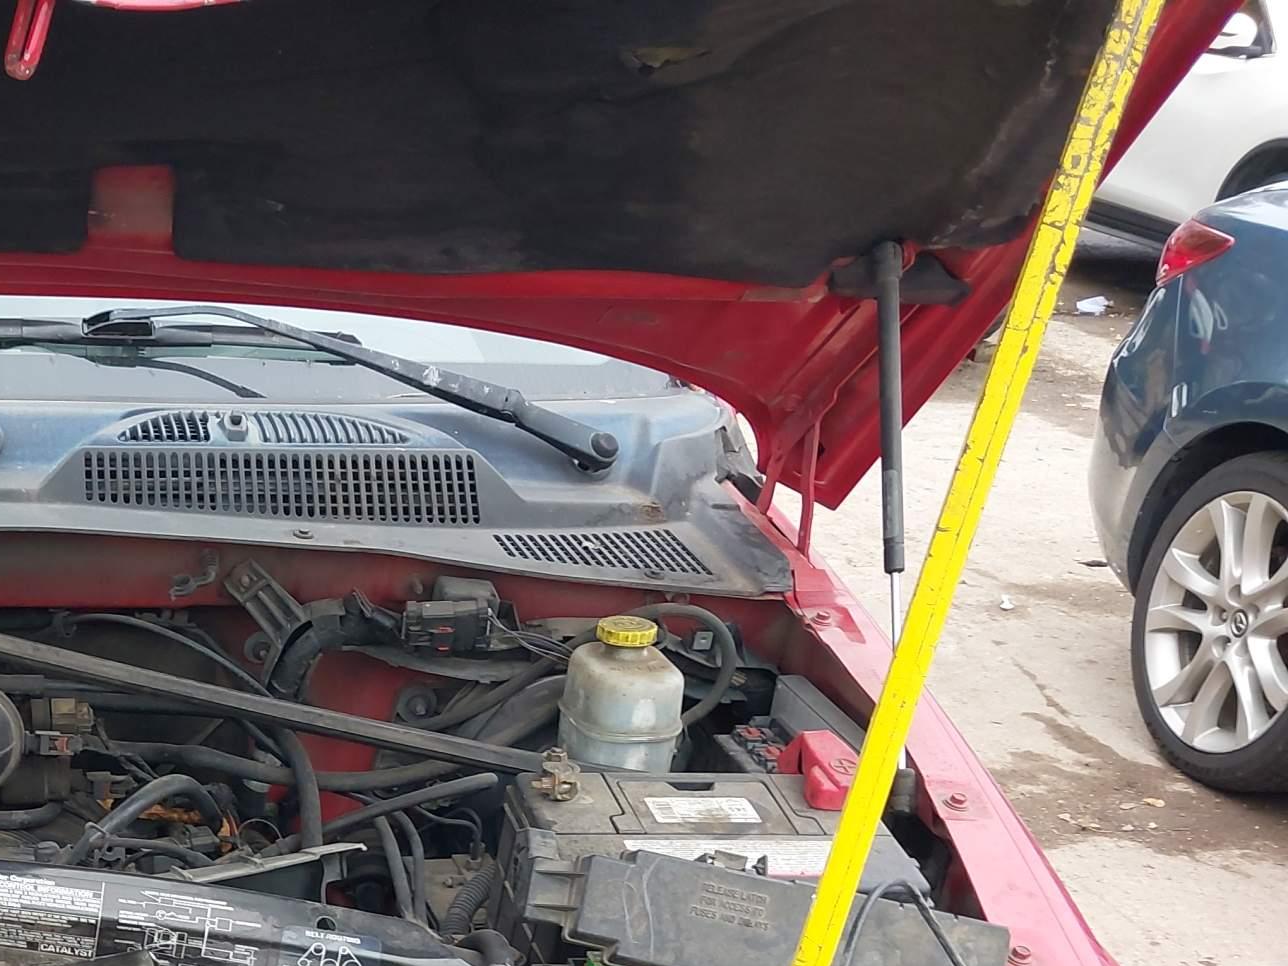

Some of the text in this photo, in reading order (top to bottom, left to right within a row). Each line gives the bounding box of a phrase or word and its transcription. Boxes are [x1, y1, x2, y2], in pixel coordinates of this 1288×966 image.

[36, 884, 94, 898] INFORMATION
[703, 881, 769, 905] RELEASE LATCH
[689, 904, 718, 920] FUSES
[699, 895, 717, 907] FOR
[719, 899, 752, 914] ACCESS
[304, 930, 361, 945] BELT ROUTING
[40, 943, 93, 958] CATALYST
